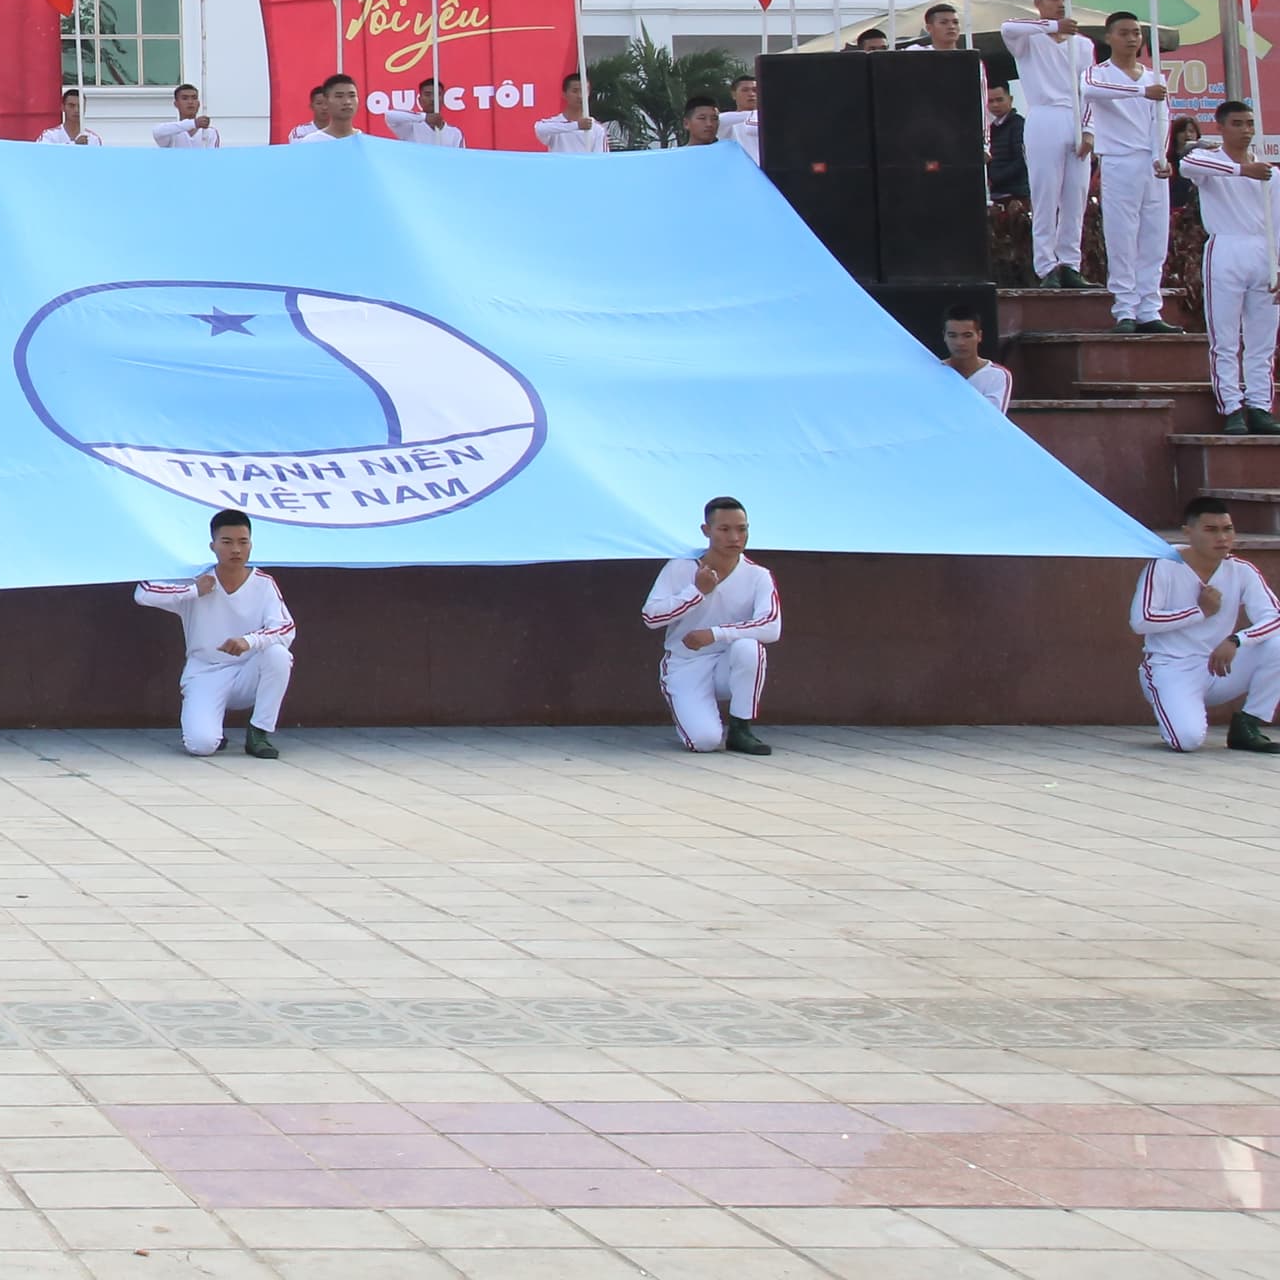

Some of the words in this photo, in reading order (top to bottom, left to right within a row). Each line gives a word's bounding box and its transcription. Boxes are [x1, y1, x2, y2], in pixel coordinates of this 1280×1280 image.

[1161, 60, 1207, 94] 70
[366, 86, 466, 116] QUC
[473, 80, 535, 110] TÔI
[167, 458, 346, 483] THANH
[358, 446, 485, 477] NIÊN
[220, 486, 332, 513] VIỆT
[351, 477, 471, 508] NAM
